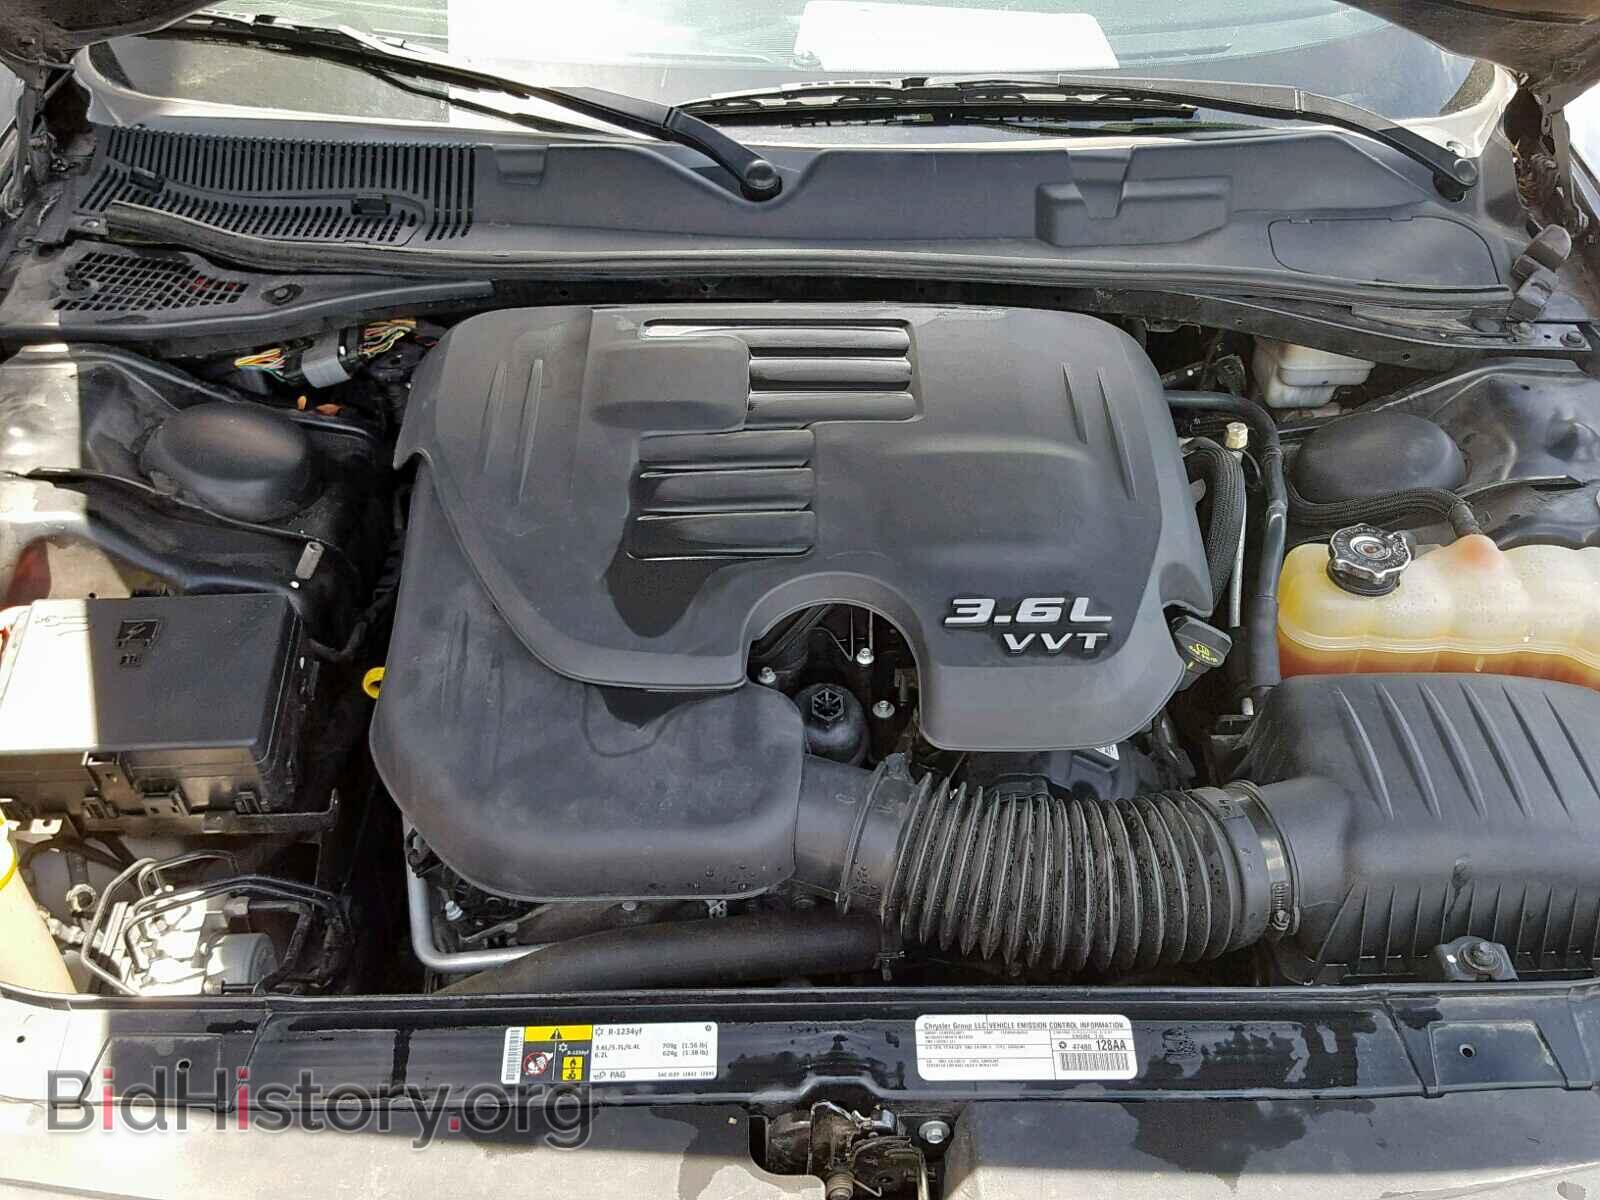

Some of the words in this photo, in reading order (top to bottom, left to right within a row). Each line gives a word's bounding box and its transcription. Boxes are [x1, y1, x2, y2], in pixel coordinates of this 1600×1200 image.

[944, 597, 1113, 625] 3.6L
[1003, 633, 1109, 652] VVT
[608, 1027, 643, 1037] R-1234yf
[923, 1022, 951, 1030] Chrysler
[952, 1022, 973, 1031] Group
[1095, 1039, 1127, 1051] 128AA
[609, 1070, 626, 1079] PAG
